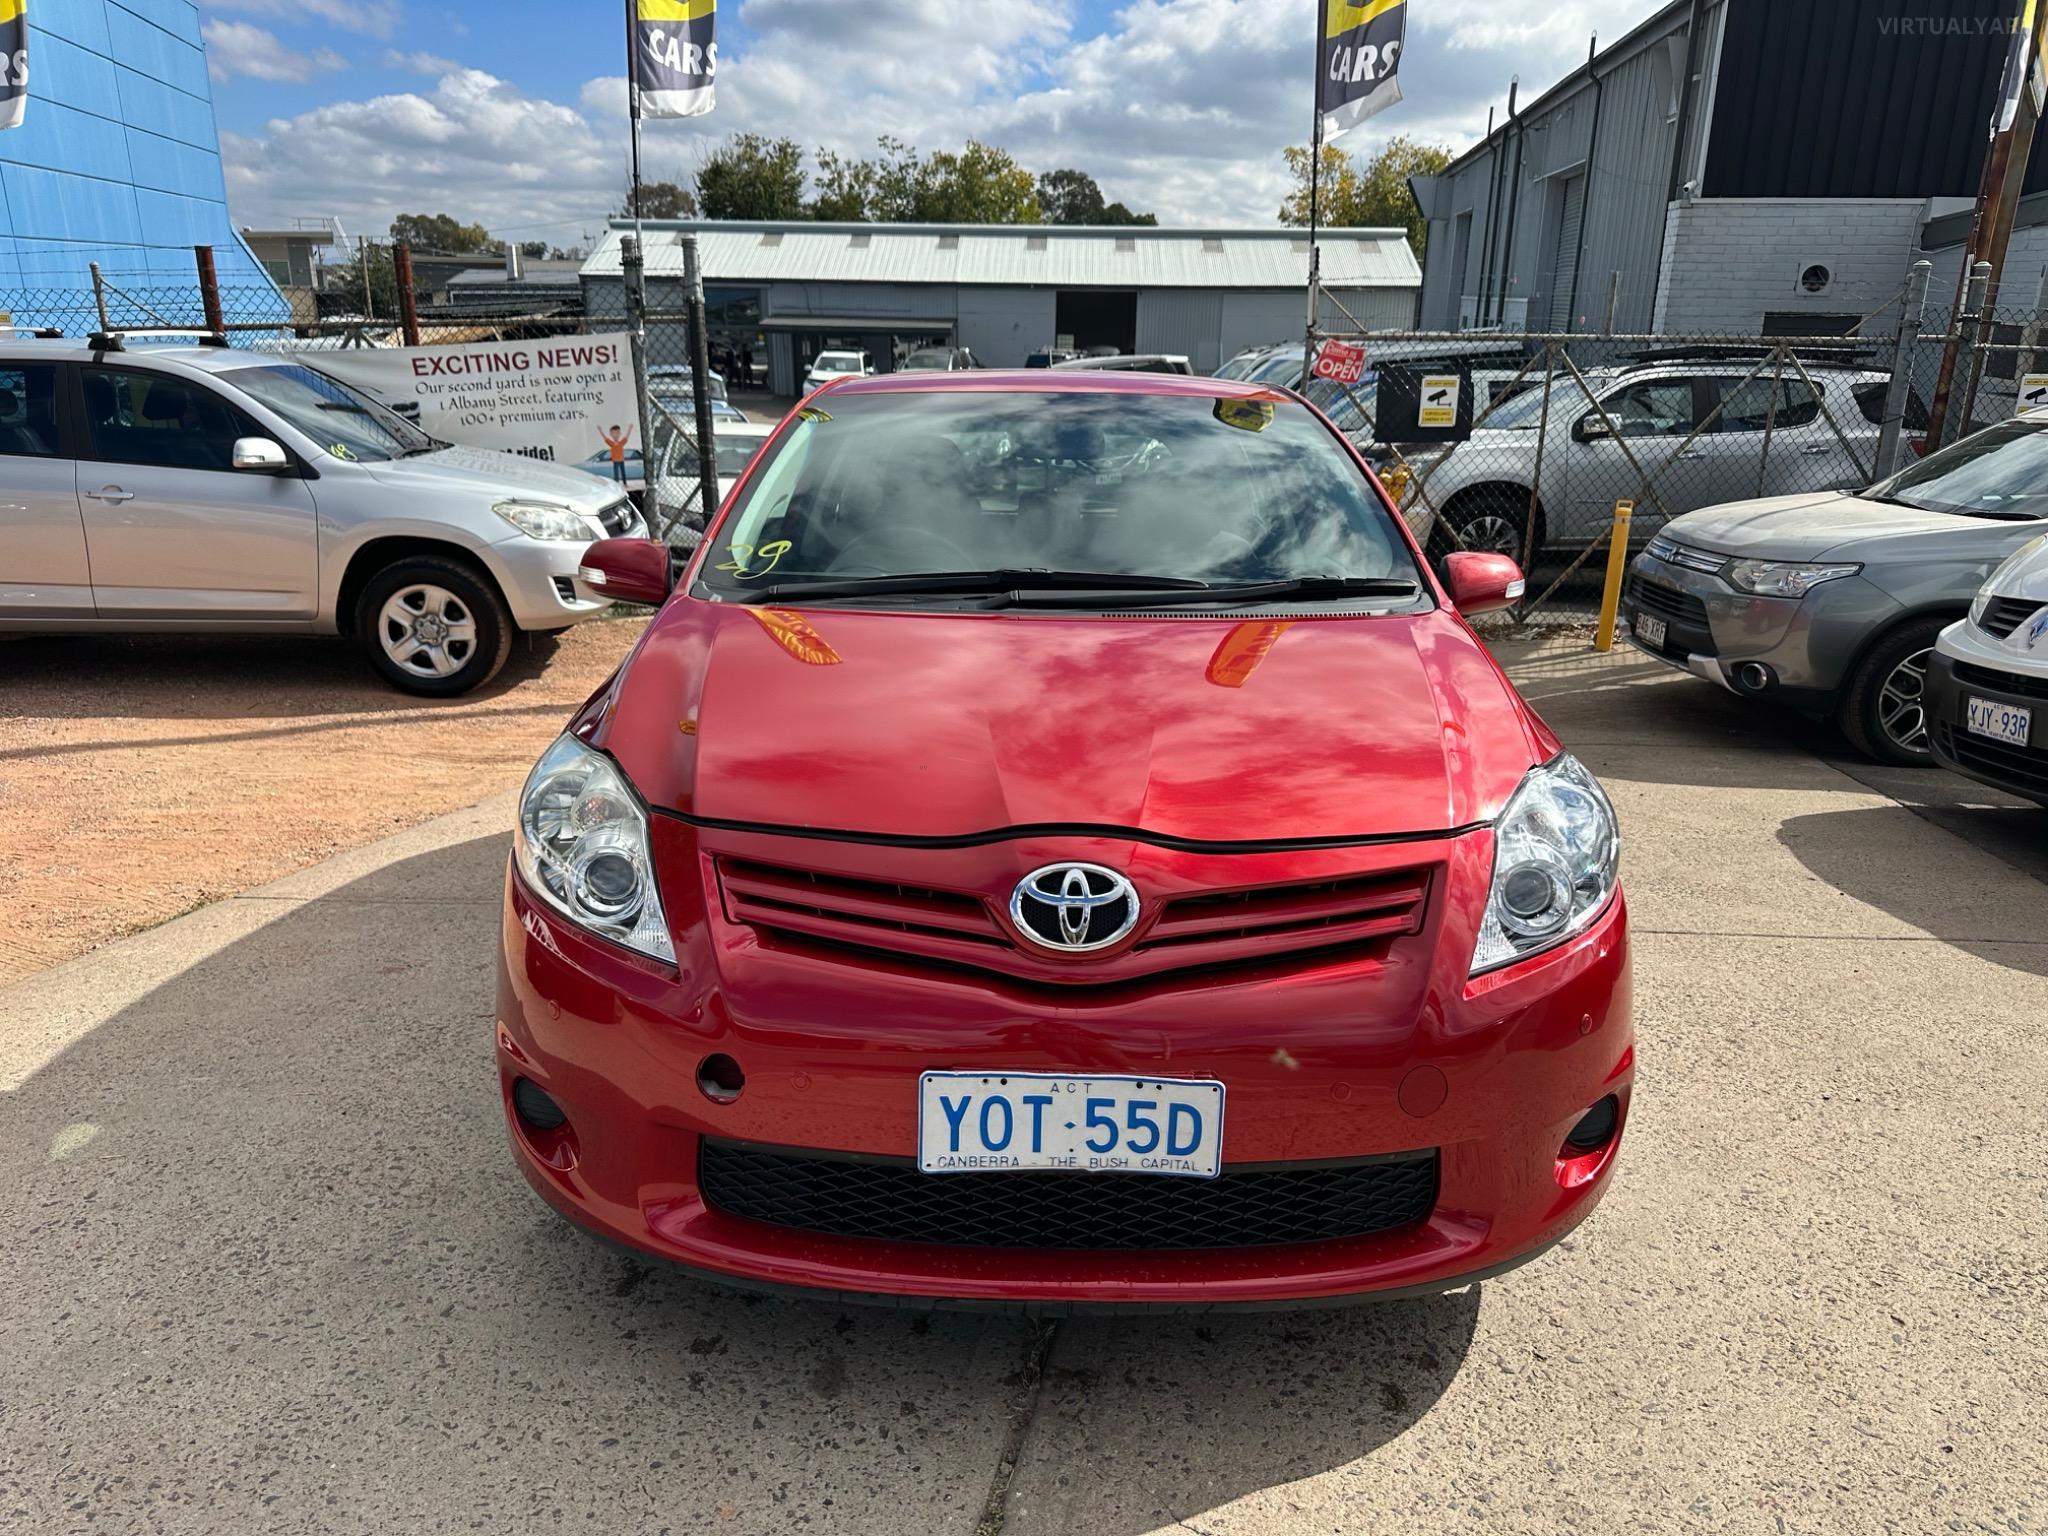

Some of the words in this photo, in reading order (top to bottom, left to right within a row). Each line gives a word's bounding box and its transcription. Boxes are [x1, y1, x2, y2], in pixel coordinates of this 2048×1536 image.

[649, 28, 718, 77] CARS
[1330, 40, 1400, 83] CARS
[411, 352, 530, 376] EXCITING
[537, 344, 618, 368] NEWS!
[1319, 358, 1362, 381] OPEN
[415, 381, 445, 394] Our
[448, 377, 492, 392] second
[495, 374, 526, 393] yard
[529, 373, 541, 387] is
[543, 375, 573, 386] now
[576, 371, 607, 388] open
[609, 370, 623, 382] at
[448, 395, 496, 411] Albany
[545, 387, 605, 405] featuring
[460, 412, 495, 426] 100+
[499, 407, 557, 427] premium
[559, 408, 589, 420] cars.
[1970, 703, 1994, 730] YJY
[2001, 711, 2027, 739] 93R
[1050, 1082, 1093, 1095] ACT
[938, 1155, 1020, 1169] CANBERRA
[1049, 1156, 1078, 1169] THE
[1089, 1156, 1129, 1170] BUSH
[1140, 1157, 1201, 1173] CAPITAL
